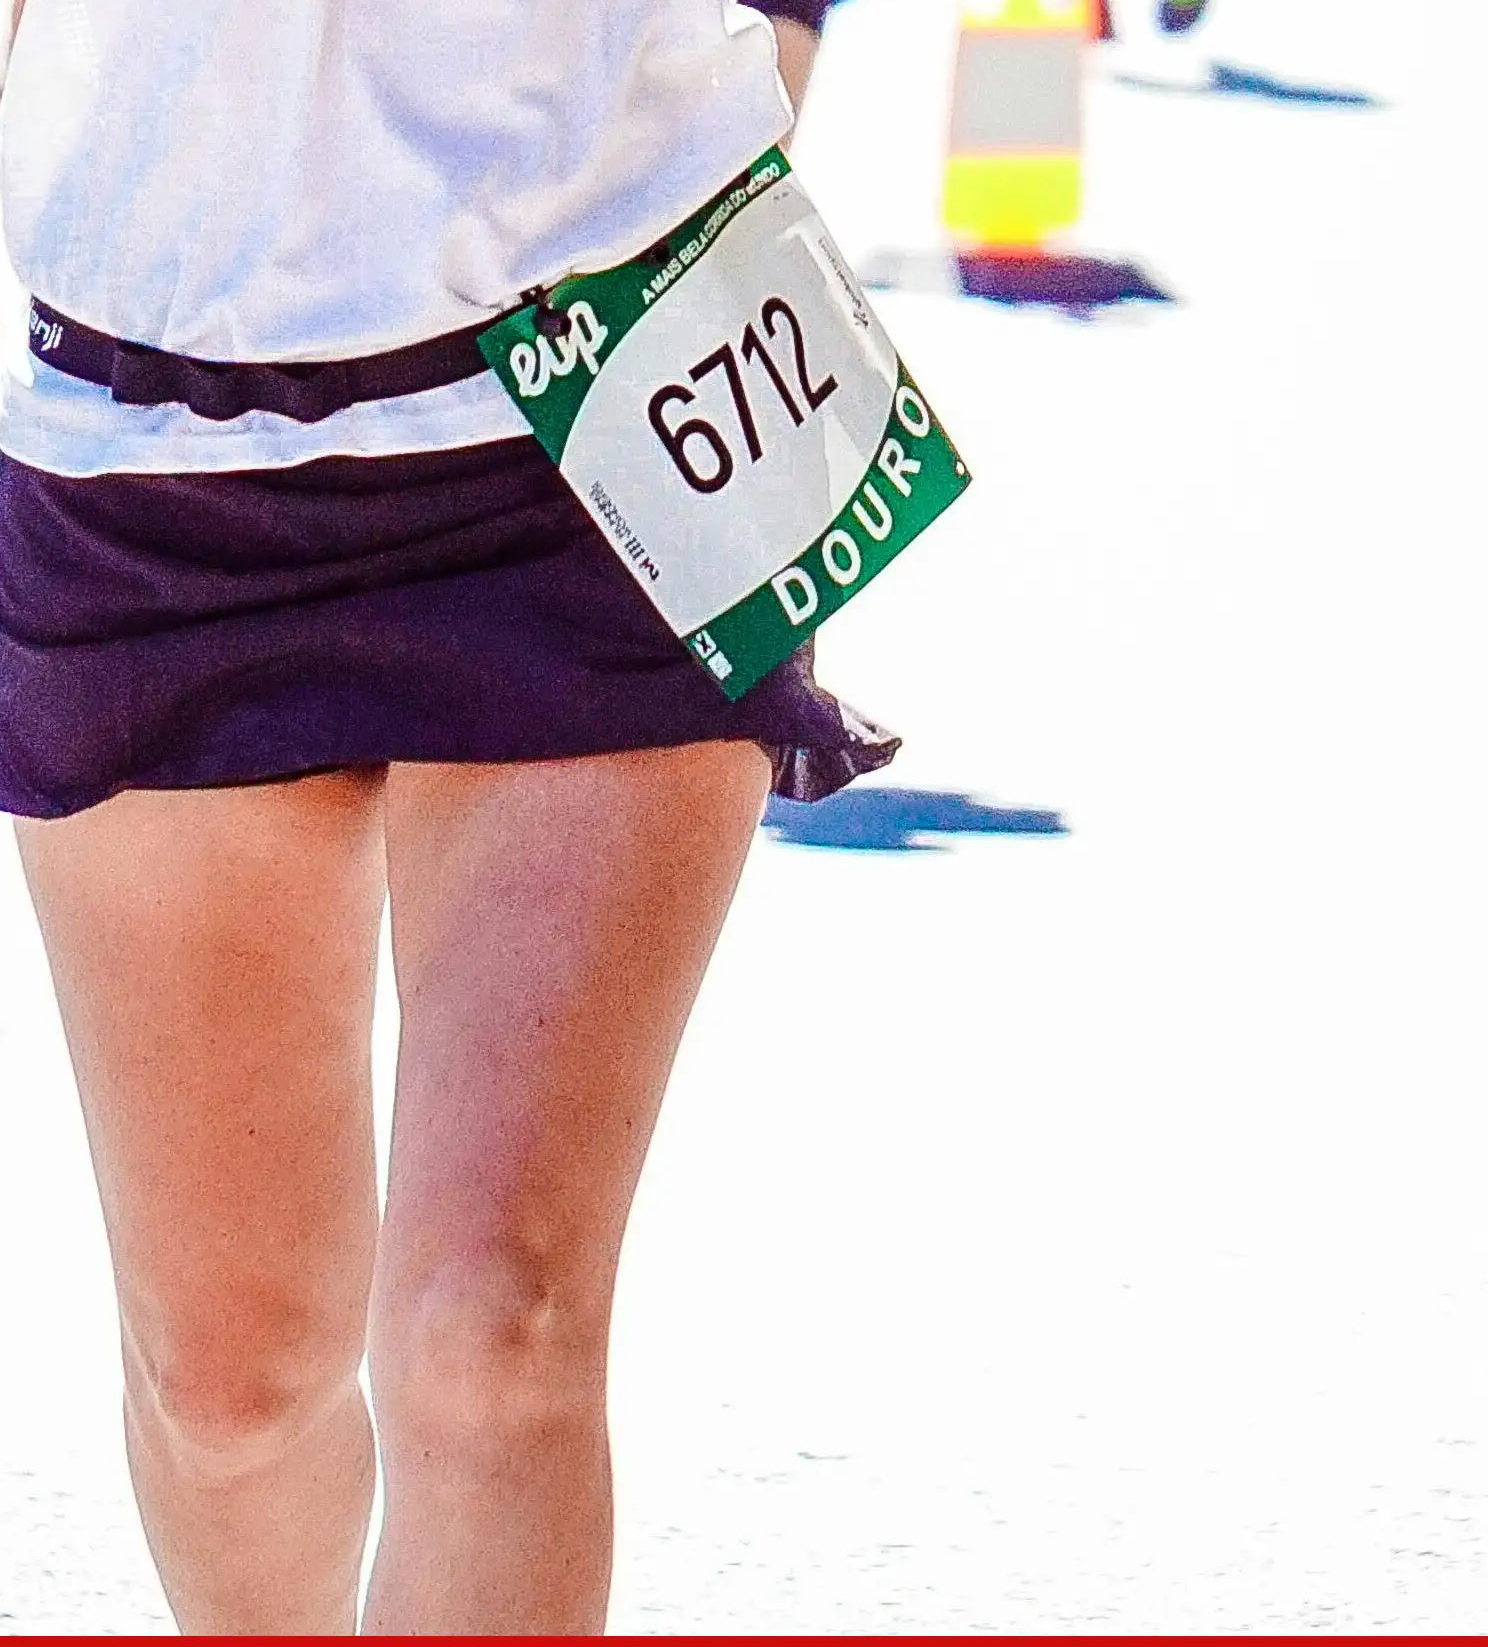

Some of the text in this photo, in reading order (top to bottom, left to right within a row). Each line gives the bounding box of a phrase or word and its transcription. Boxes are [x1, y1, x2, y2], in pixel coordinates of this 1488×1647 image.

[641, 288, 655, 304] A
[650, 258, 683, 293] MAIS
[678, 232, 709, 265] BELA
[648, 297, 838, 493] 6712
[771, 385, 930, 625] DOURO
